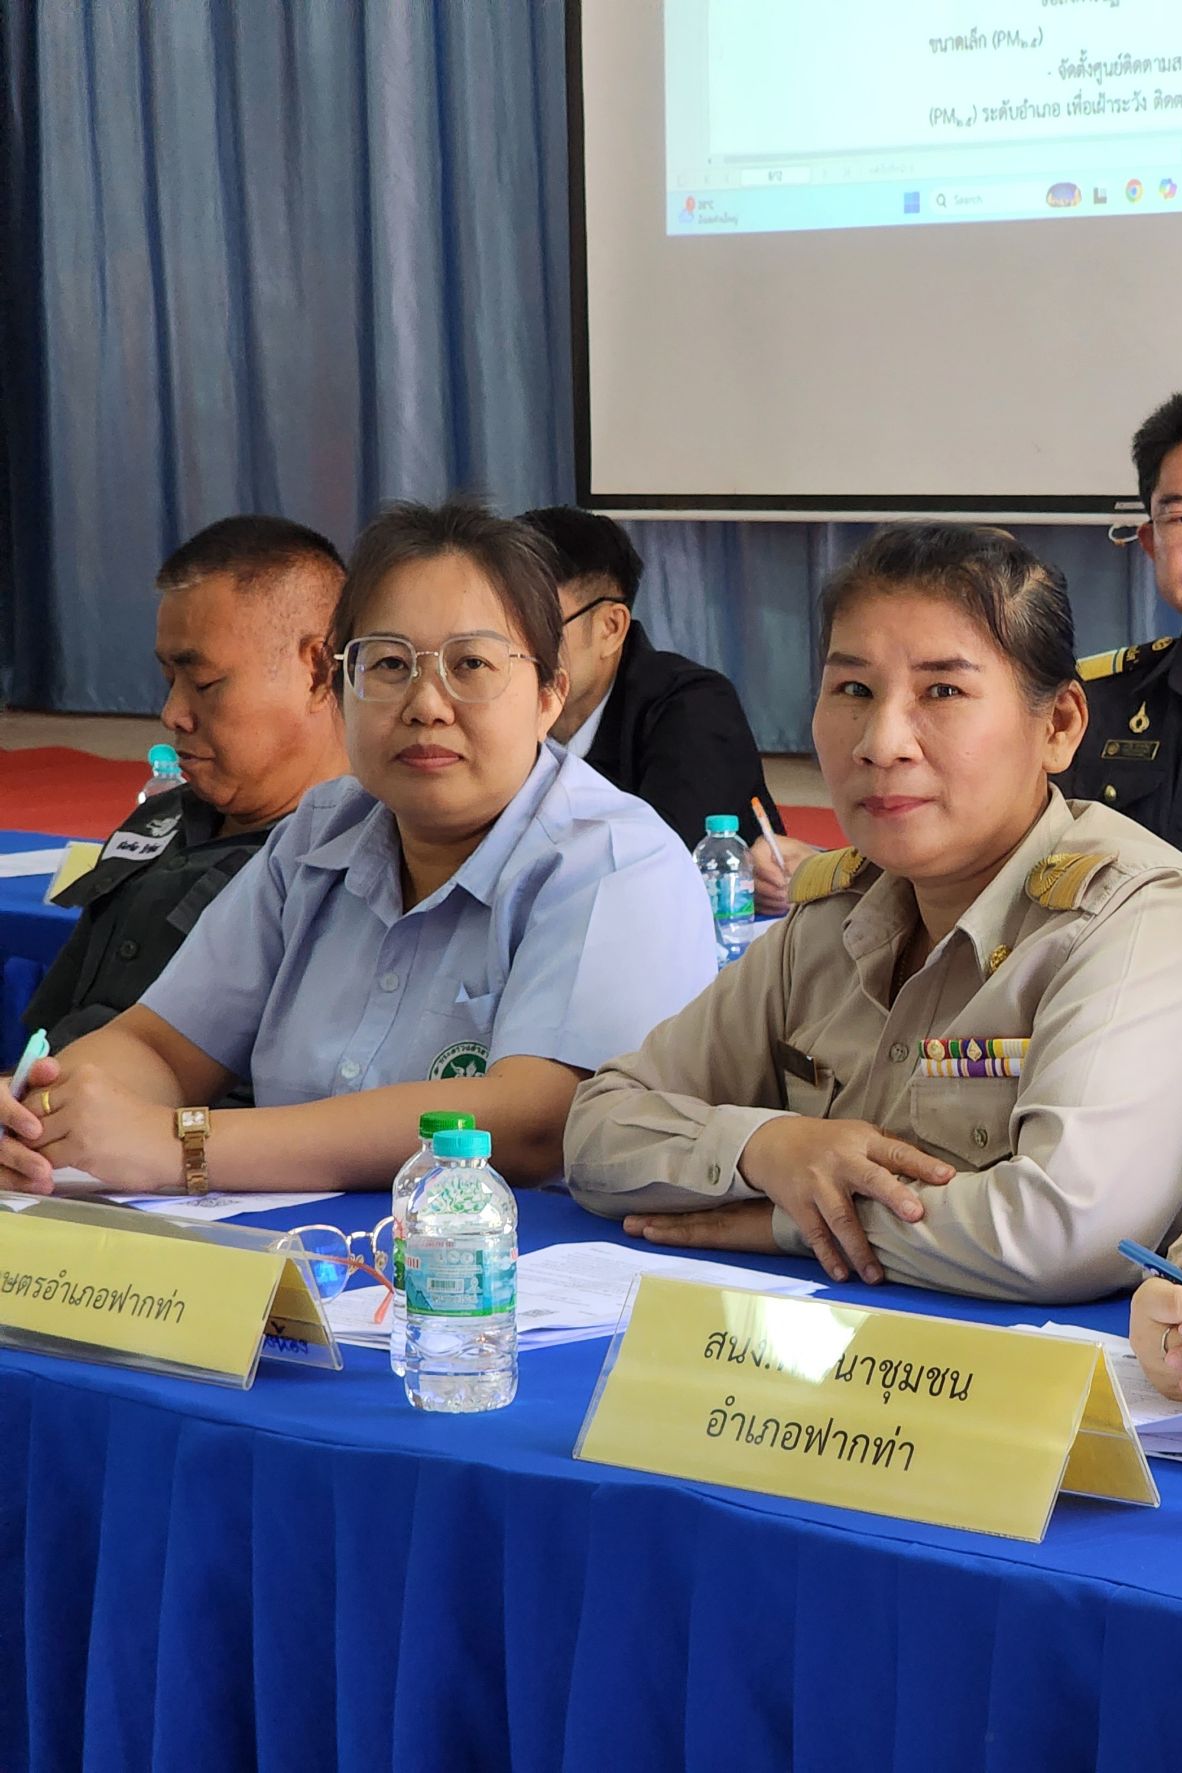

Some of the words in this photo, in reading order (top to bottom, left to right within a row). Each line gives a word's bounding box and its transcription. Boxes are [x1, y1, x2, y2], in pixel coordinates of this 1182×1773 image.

[928, 27, 987, 53] ขนาดเล็ก
[982, 97, 1061, 122] ระดับอำเภอ
[1066, 89, 1148, 116] เพื่อเฝ้าระวัง
[0, 1268, 186, 1325] ษตรอำเภอฟากท่า
[706, 1394, 915, 1472] อำเภอฟากท่า
